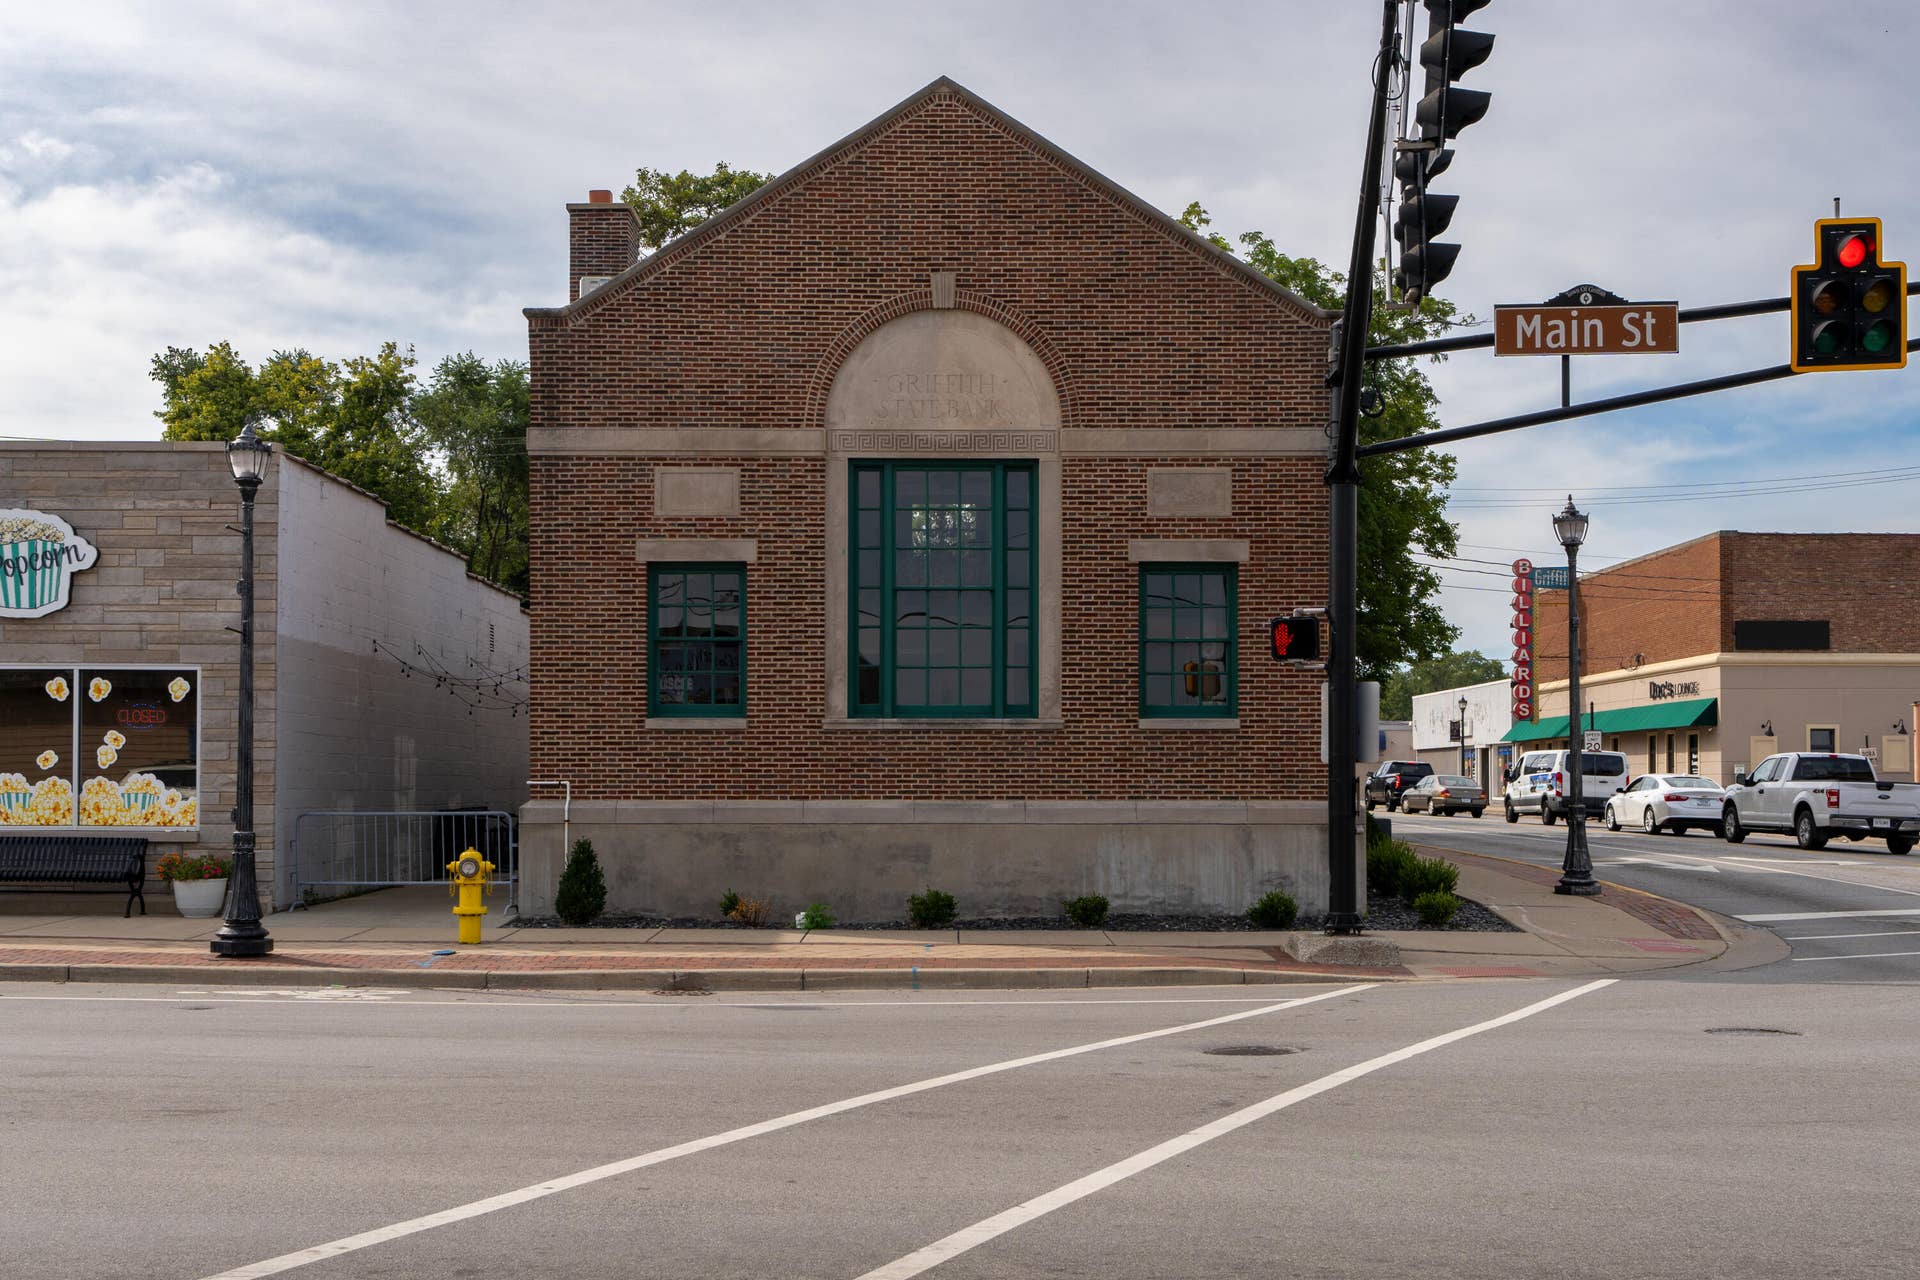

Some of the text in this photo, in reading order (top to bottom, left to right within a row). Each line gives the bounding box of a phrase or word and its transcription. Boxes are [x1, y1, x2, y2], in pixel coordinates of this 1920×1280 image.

[1516, 310, 1656, 349] Main St
[887, 374, 996, 394] GRIFFITH
[878, 399, 1001, 418] STATE BANK
[0, 545, 86, 586] opcorn
[1535, 569, 1569, 586] Griffit
[1518, 560, 1531, 717] BILLIARDS
[117, 709, 167, 724] CLOSED
[1586, 742, 1601, 750] 20
